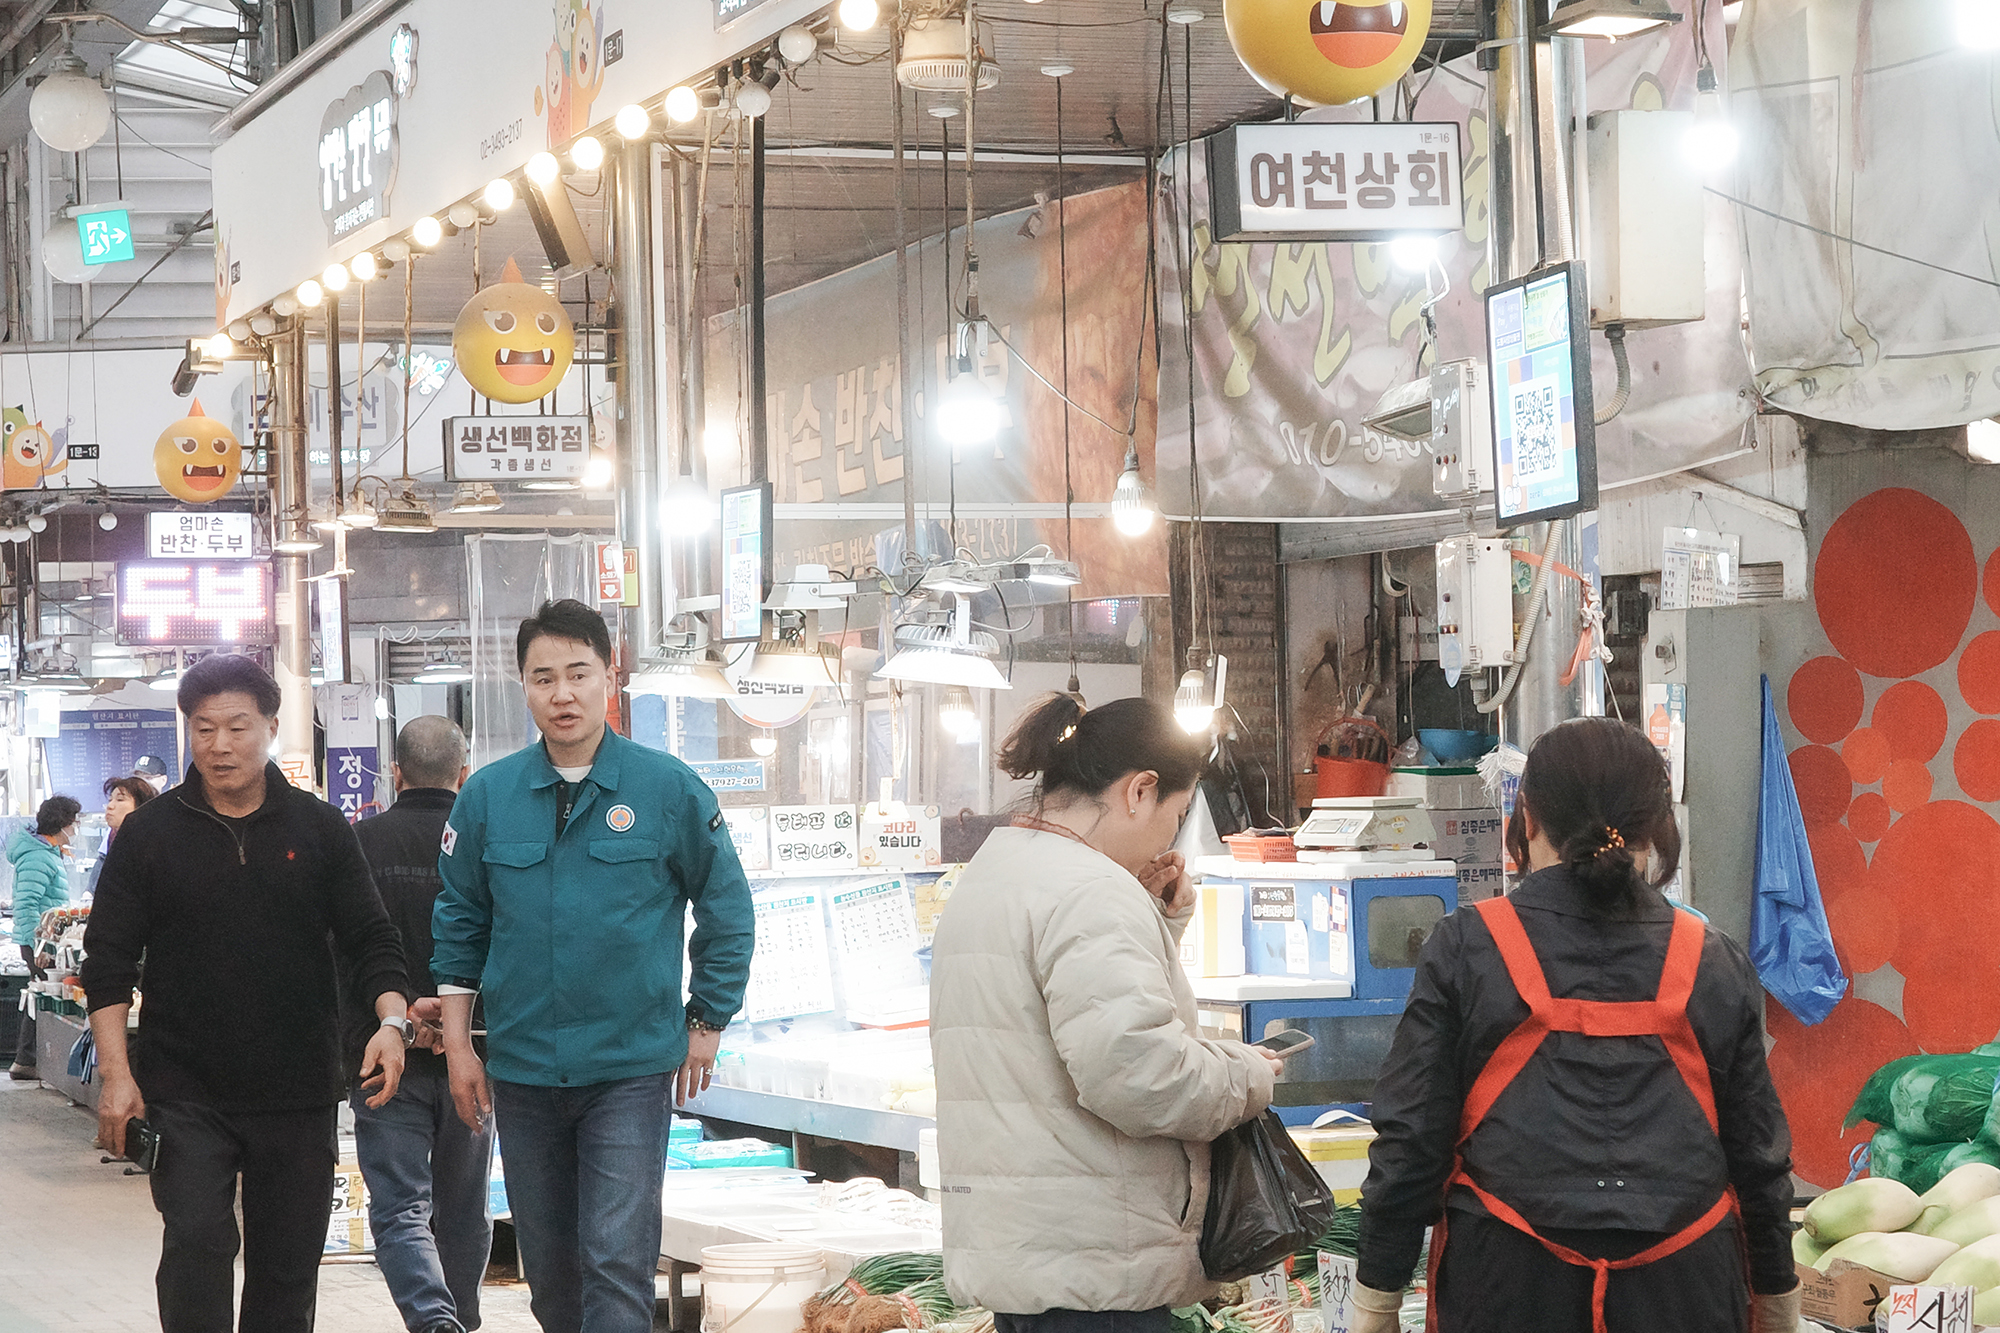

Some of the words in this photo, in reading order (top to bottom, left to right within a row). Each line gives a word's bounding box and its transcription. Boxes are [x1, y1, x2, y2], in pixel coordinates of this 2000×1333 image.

[1250, 149, 1451, 210] 여천상회
[460, 424, 583, 454] 생선백화점
[179, 515, 224, 532] 엄마손
[121, 565, 268, 641] 두부
[883, 821, 917, 834] 코다리
[878, 836, 922, 848] 있습니다
